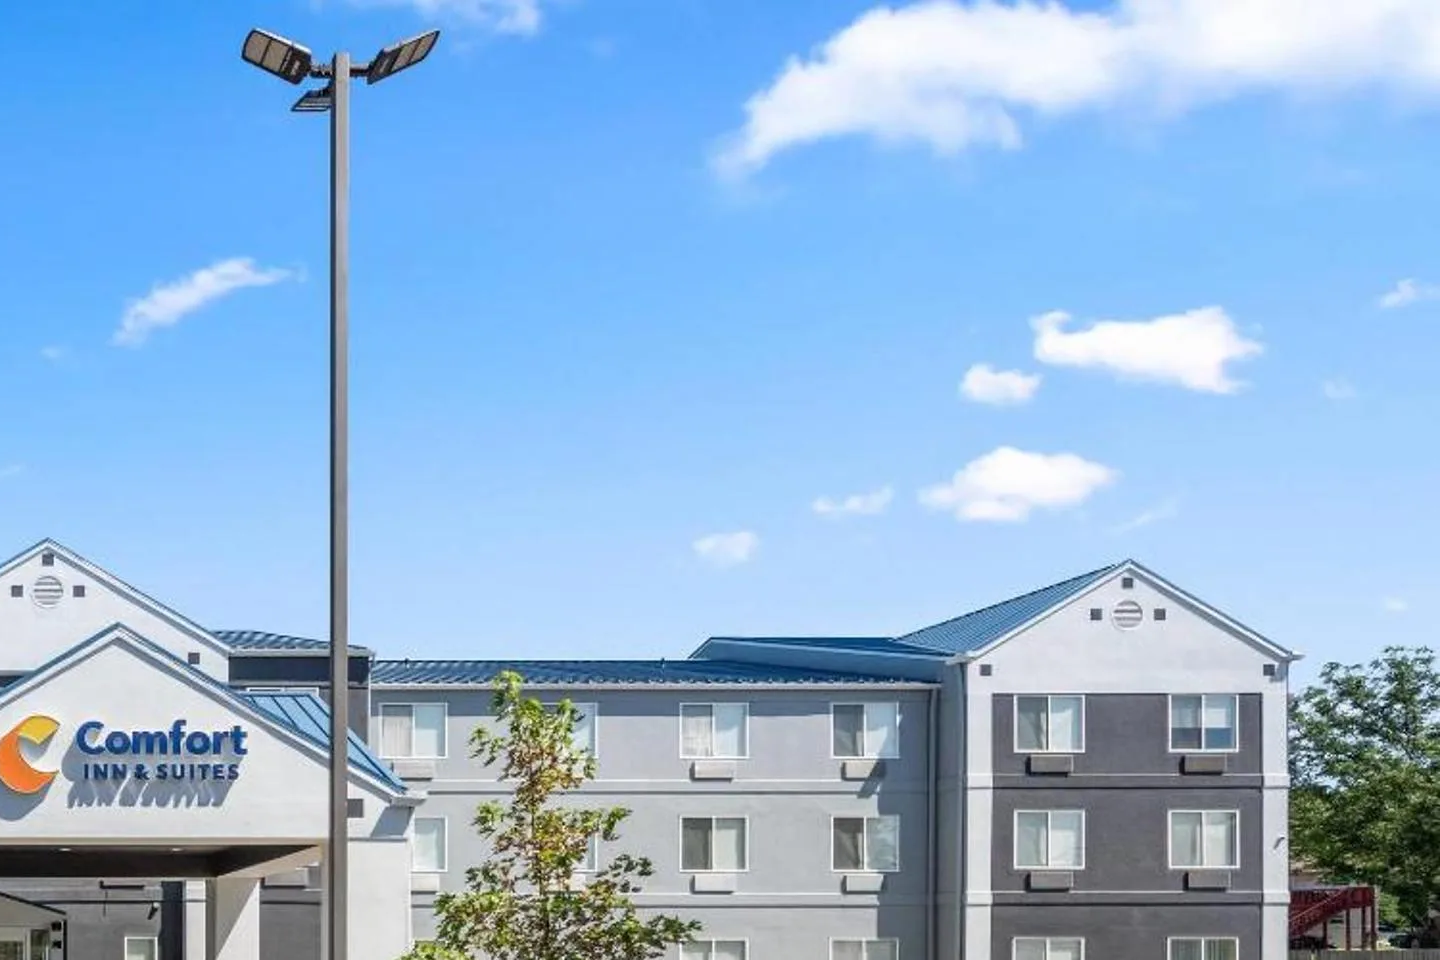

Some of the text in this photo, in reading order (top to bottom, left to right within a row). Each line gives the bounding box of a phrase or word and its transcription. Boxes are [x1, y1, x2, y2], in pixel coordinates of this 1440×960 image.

[76, 719, 248, 755] Comfort
[84, 763, 240, 780] INN & SUITES
